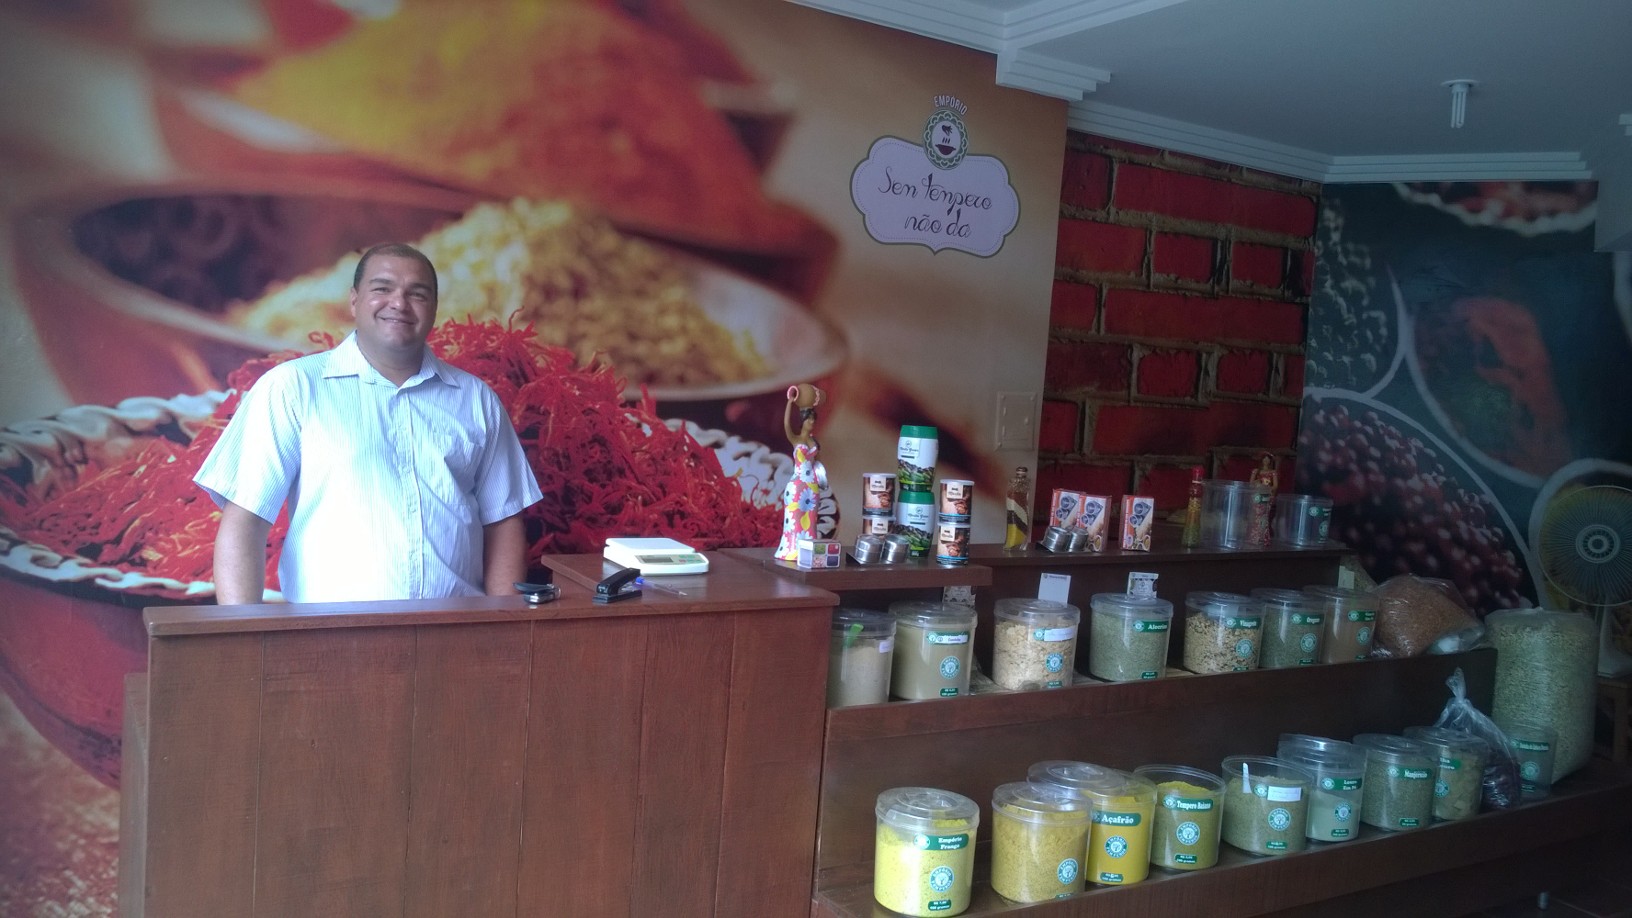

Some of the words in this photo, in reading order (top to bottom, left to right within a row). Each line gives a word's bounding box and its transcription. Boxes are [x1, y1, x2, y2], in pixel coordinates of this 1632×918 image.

[934, 95, 967, 115] EMPÓRIO
[904, 214, 942, 233] não
[1101, 815, 1134, 824] Açafrão
